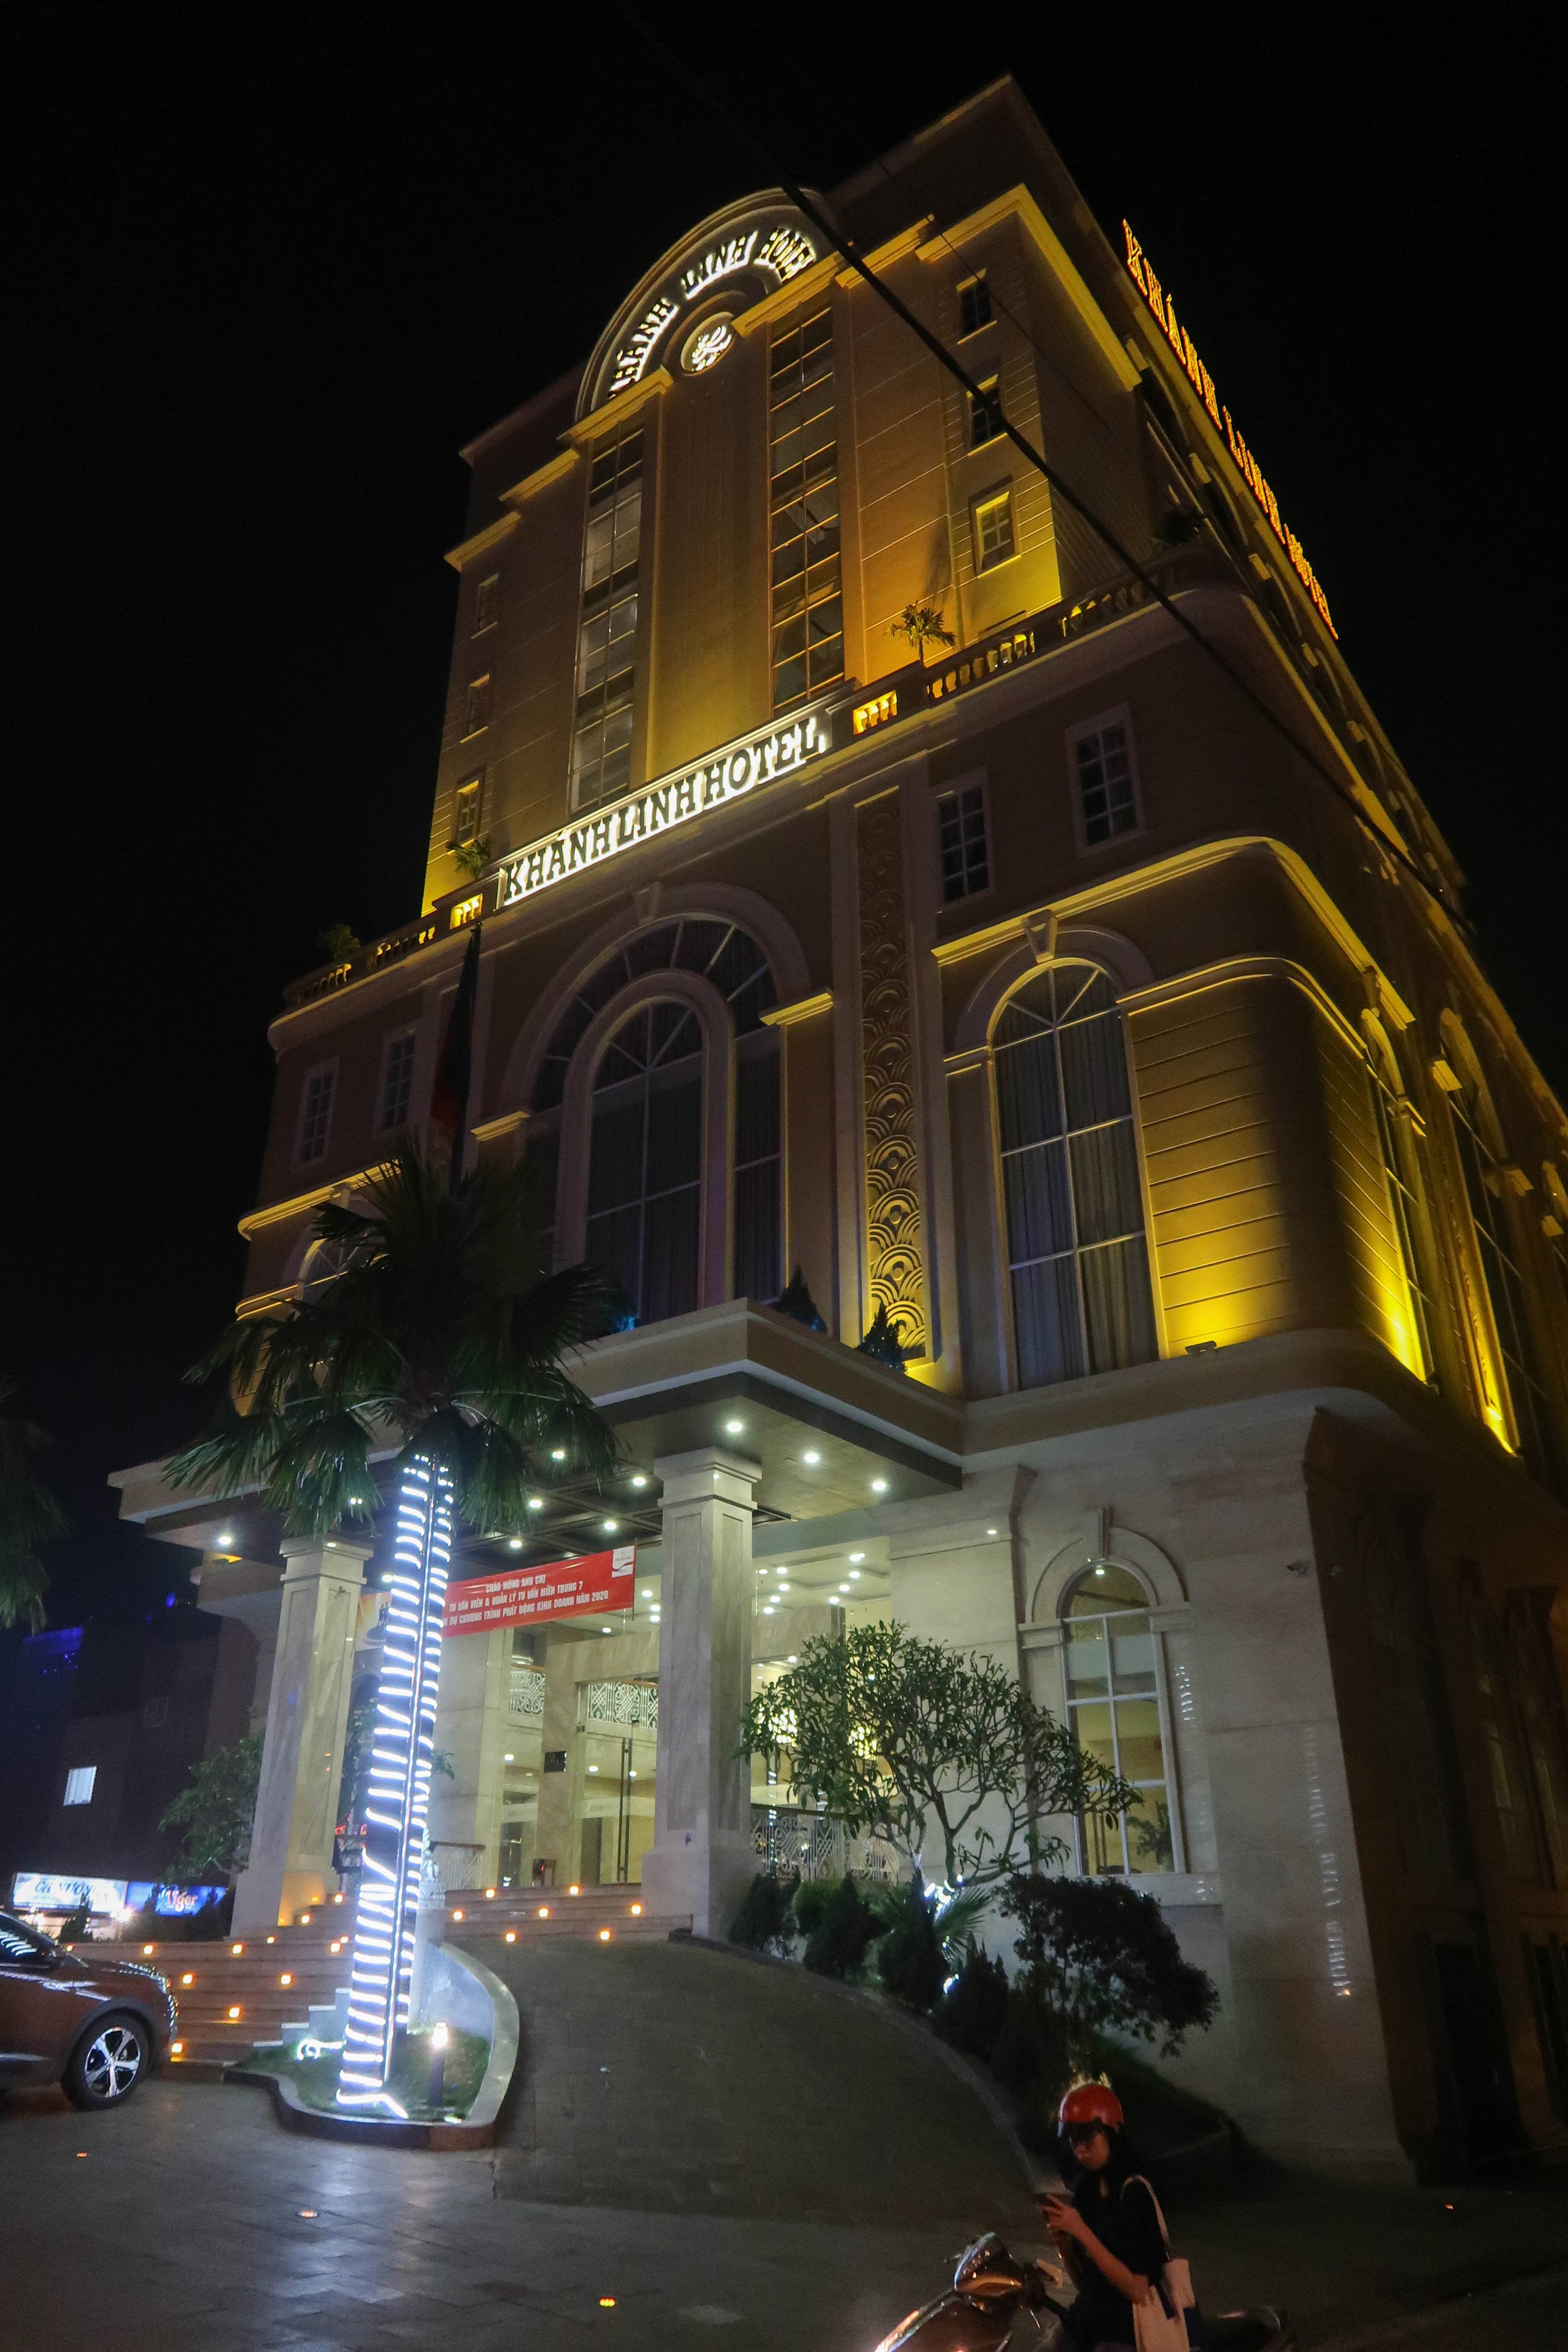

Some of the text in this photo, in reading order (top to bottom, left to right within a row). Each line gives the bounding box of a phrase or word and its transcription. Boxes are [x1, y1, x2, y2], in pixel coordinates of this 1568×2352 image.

[616, 772, 697, 849] LINH
[703, 717, 819, 807] HOTEL
[484, 1597, 490, 1607] &
[557, 1582, 577, 1594] TRUNG
[579, 1580, 583, 1590] 7
[537, 1600, 552, 1611] KINH
[554, 1596, 574, 1608] DOANH
[591, 1589, 609, 1602] 2020
[165, 1888, 198, 1912] Tiger
